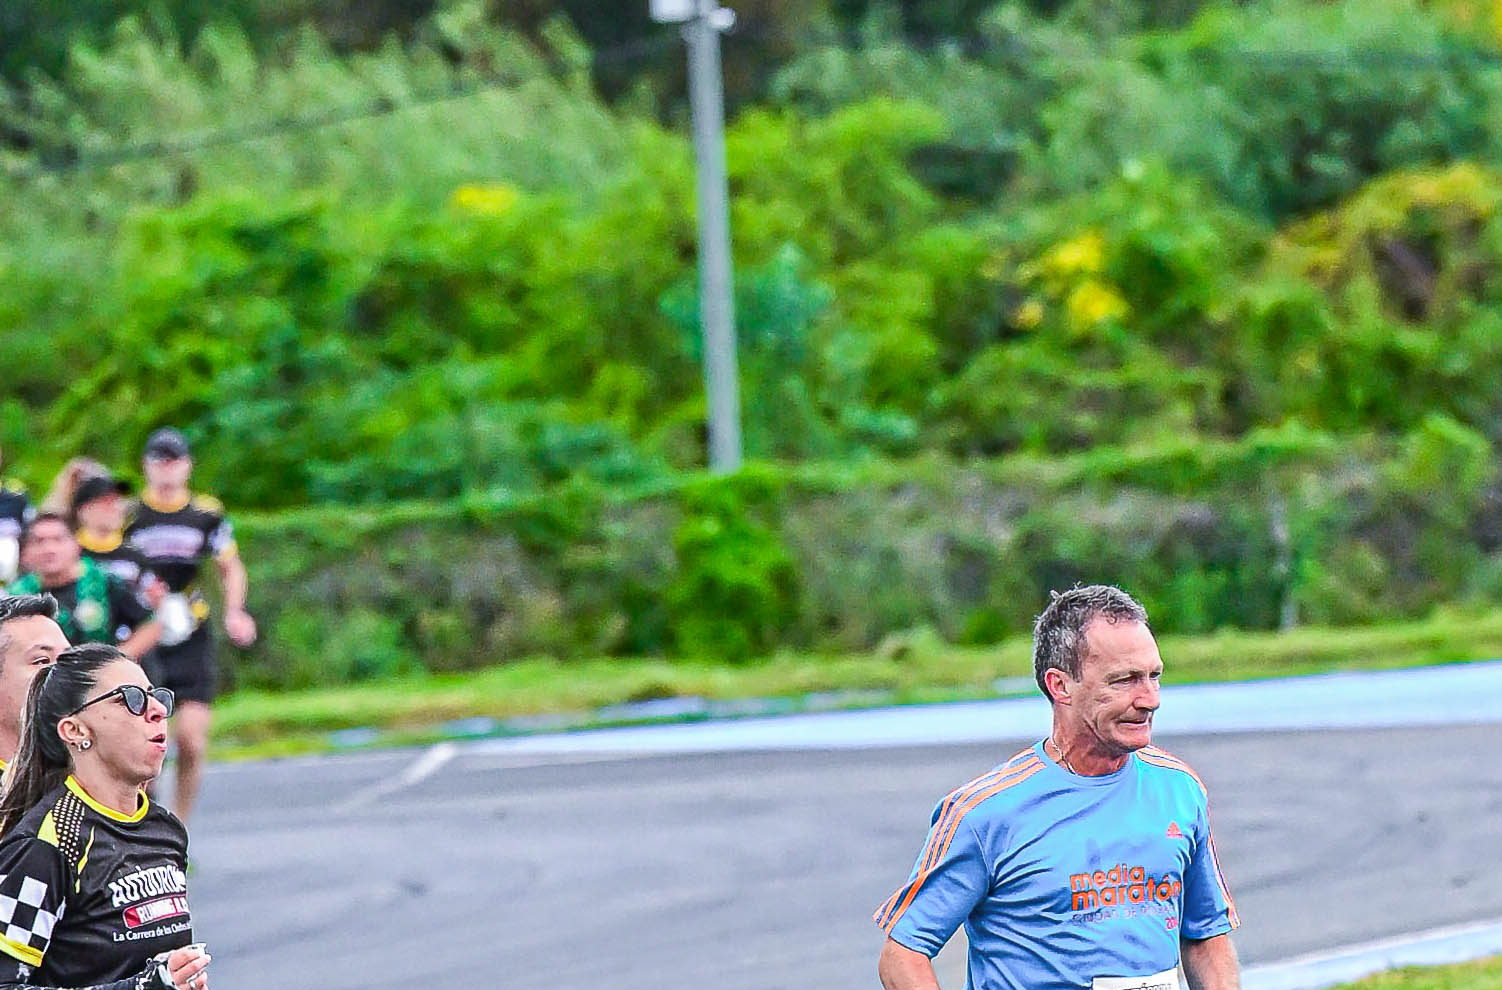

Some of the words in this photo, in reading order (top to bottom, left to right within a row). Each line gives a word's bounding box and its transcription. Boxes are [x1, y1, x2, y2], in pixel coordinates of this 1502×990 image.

[1070, 863, 1145, 891] media
[1072, 875, 1182, 911] maratón
[112, 931, 125, 942] La
[126, 930, 156, 940] Carrera
